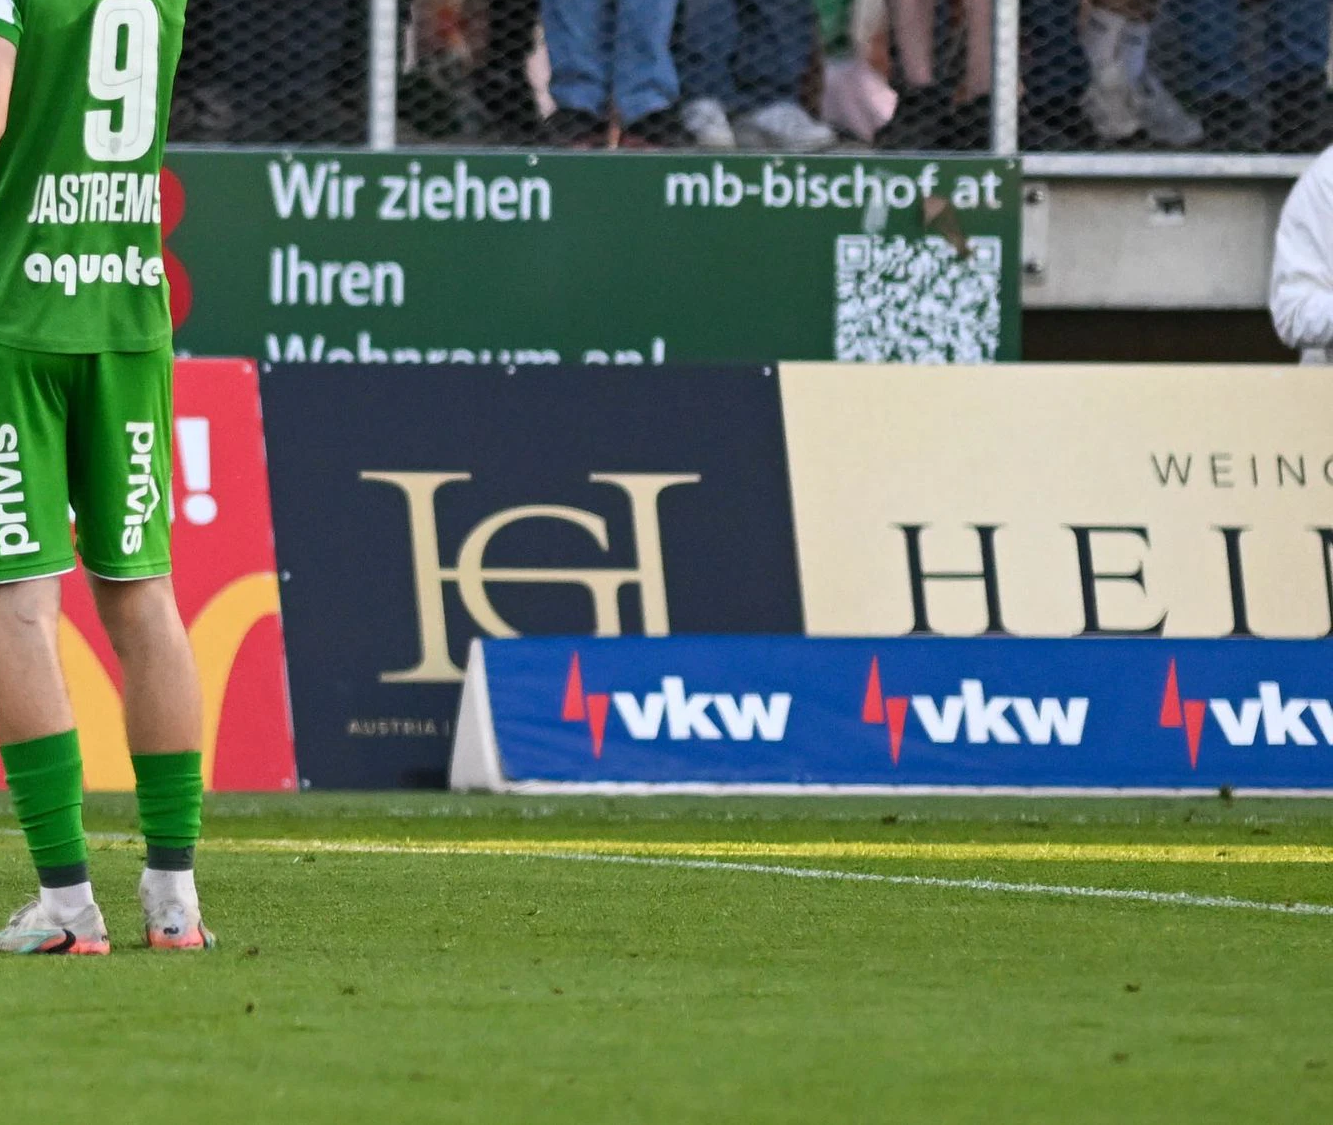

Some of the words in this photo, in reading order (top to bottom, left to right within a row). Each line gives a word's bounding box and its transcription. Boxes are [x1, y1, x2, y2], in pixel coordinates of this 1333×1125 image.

[267, 163, 365, 219] Wir
[377, 165, 553, 222] ziehen
[269, 246, 405, 306] Ihren
[121, 421, 155, 556] privis
[347, 718, 437, 736] AUSTRIA
[611, 675, 792, 741] vkw
[912, 678, 1090, 745] vkw
